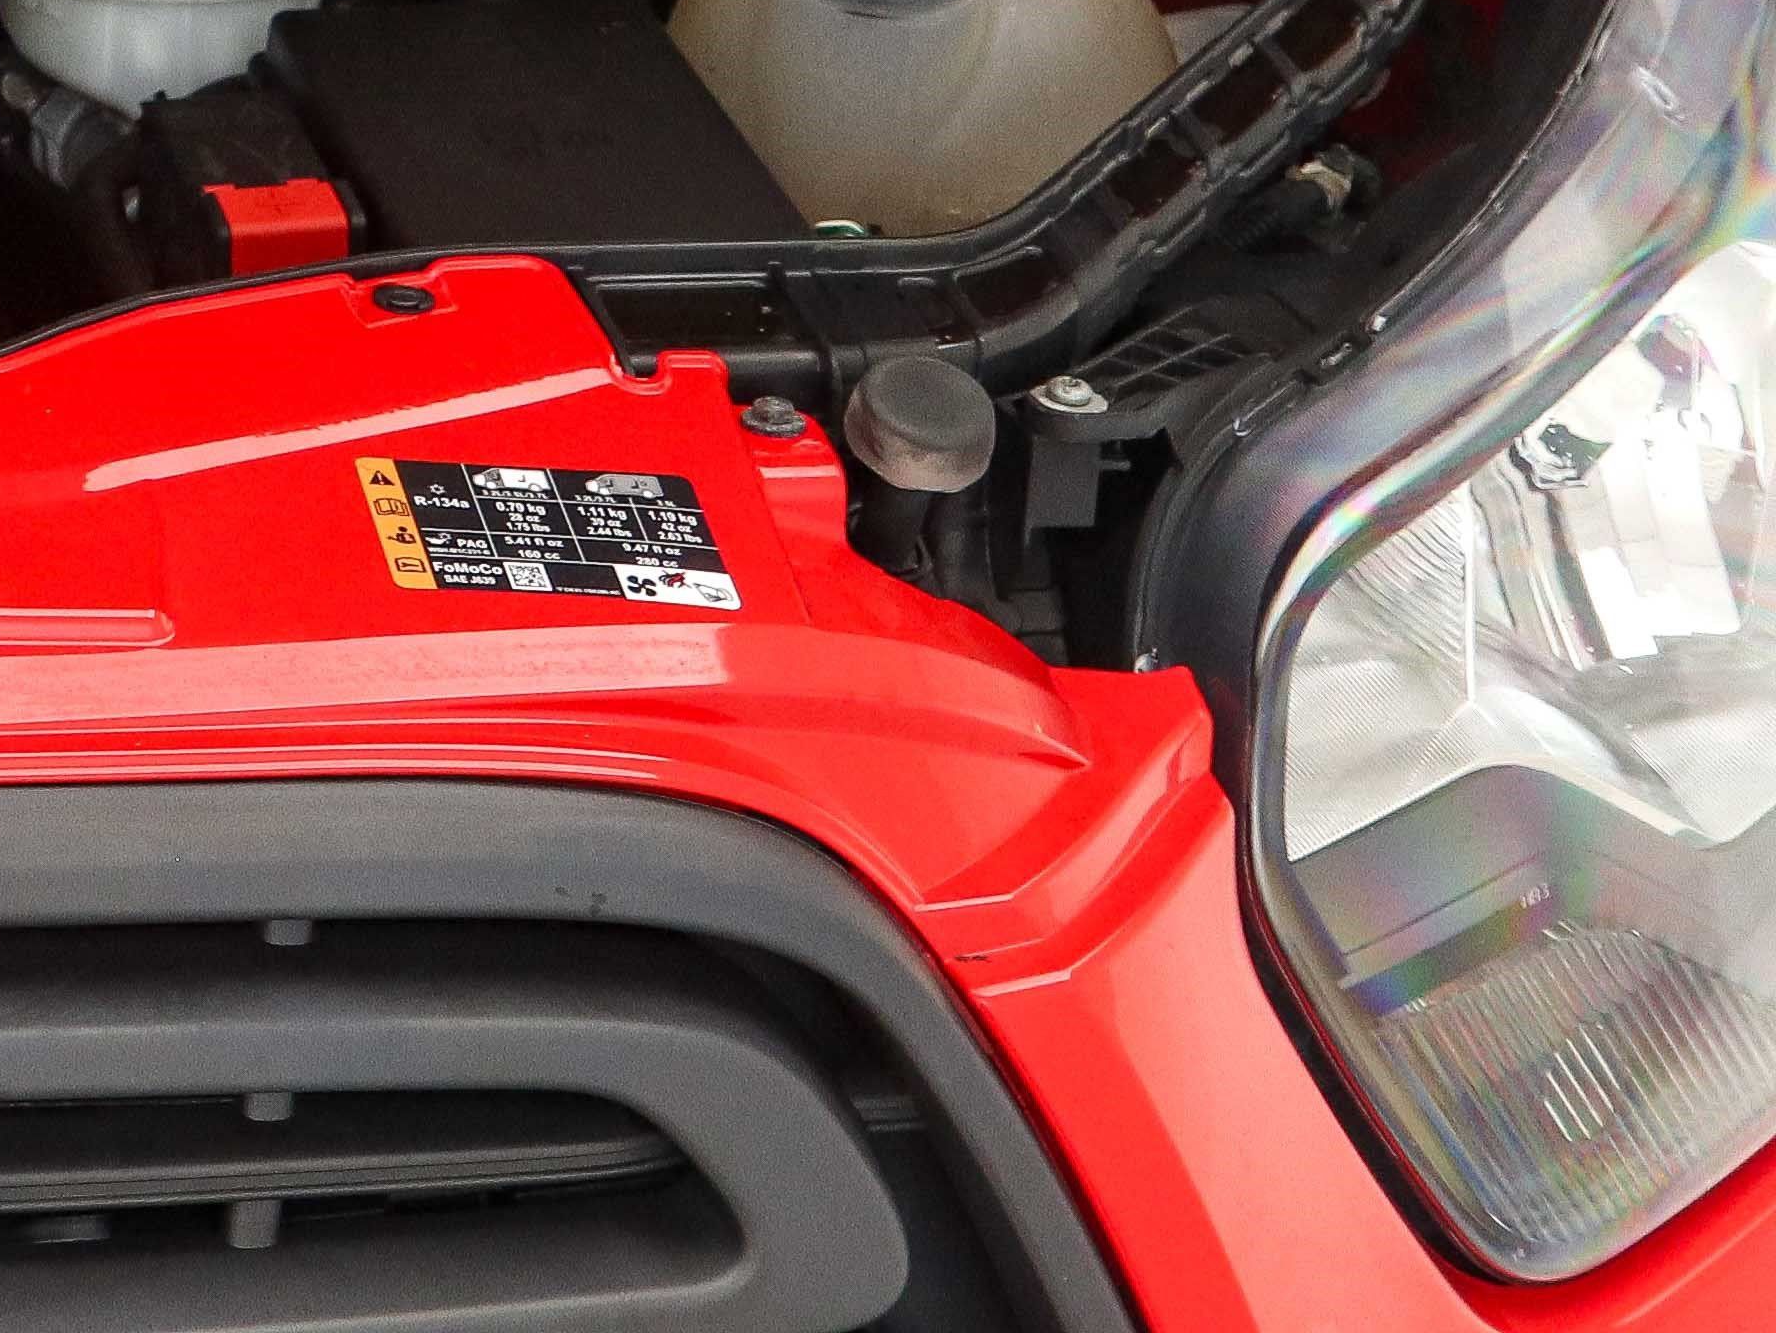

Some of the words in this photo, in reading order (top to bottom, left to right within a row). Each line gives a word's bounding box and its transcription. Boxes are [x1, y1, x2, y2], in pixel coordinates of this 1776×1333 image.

[413, 496, 471, 509] R-134a
[527, 503, 546, 516] kg
[608, 508, 628, 521] kg
[678, 513, 698, 526] kg
[456, 538, 488, 549] PAG
[432, 561, 503, 575] FoMoCo
